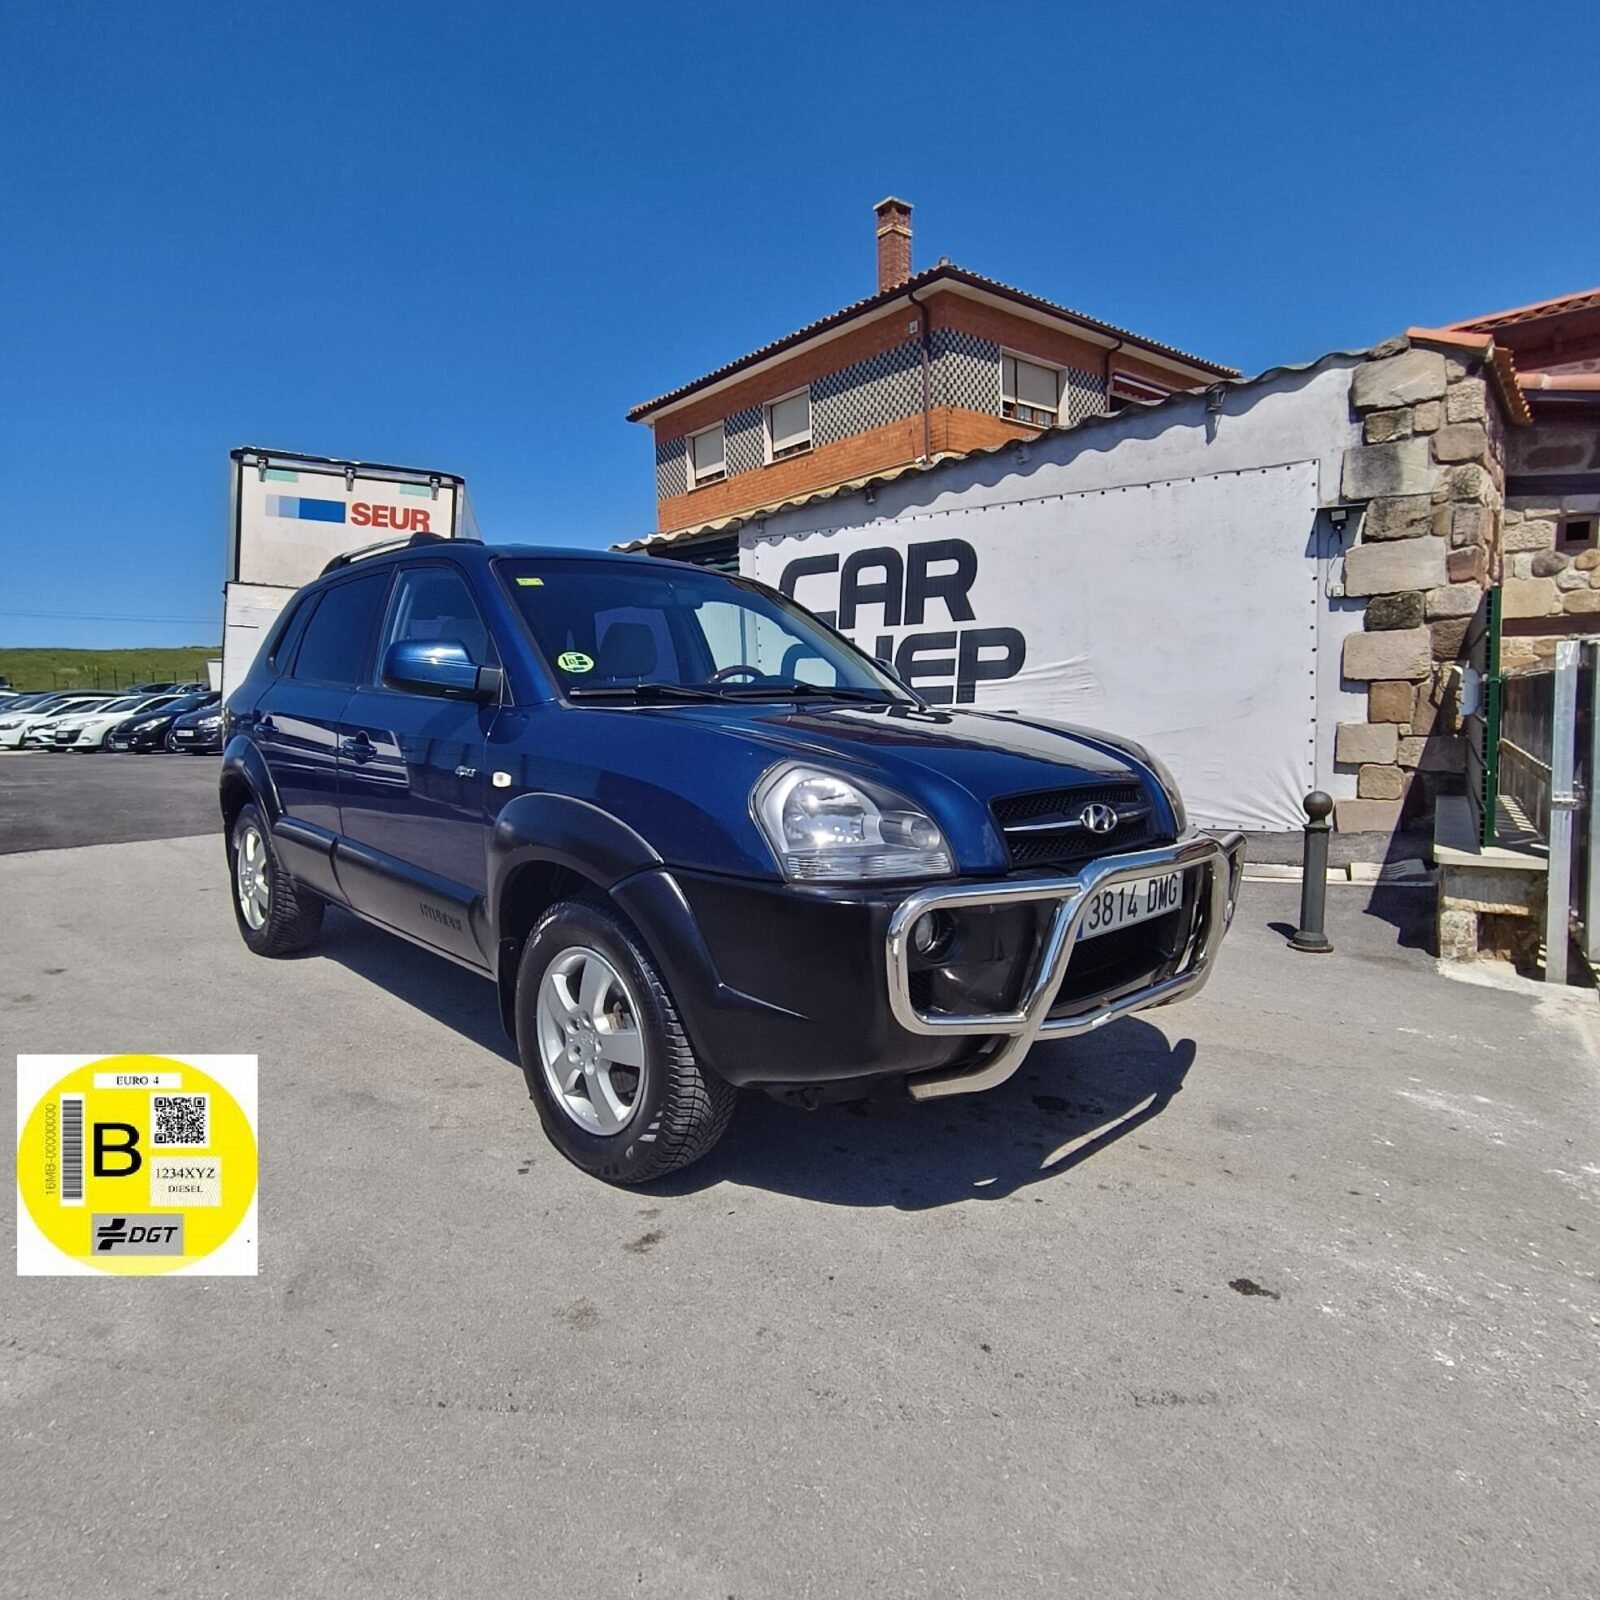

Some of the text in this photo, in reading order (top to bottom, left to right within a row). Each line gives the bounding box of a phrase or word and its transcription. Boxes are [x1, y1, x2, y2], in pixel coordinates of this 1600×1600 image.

[350, 502, 430, 534] SEUR
[778, 538, 977, 630] CAR
[1088, 873, 1178, 930] 3814 DMG
